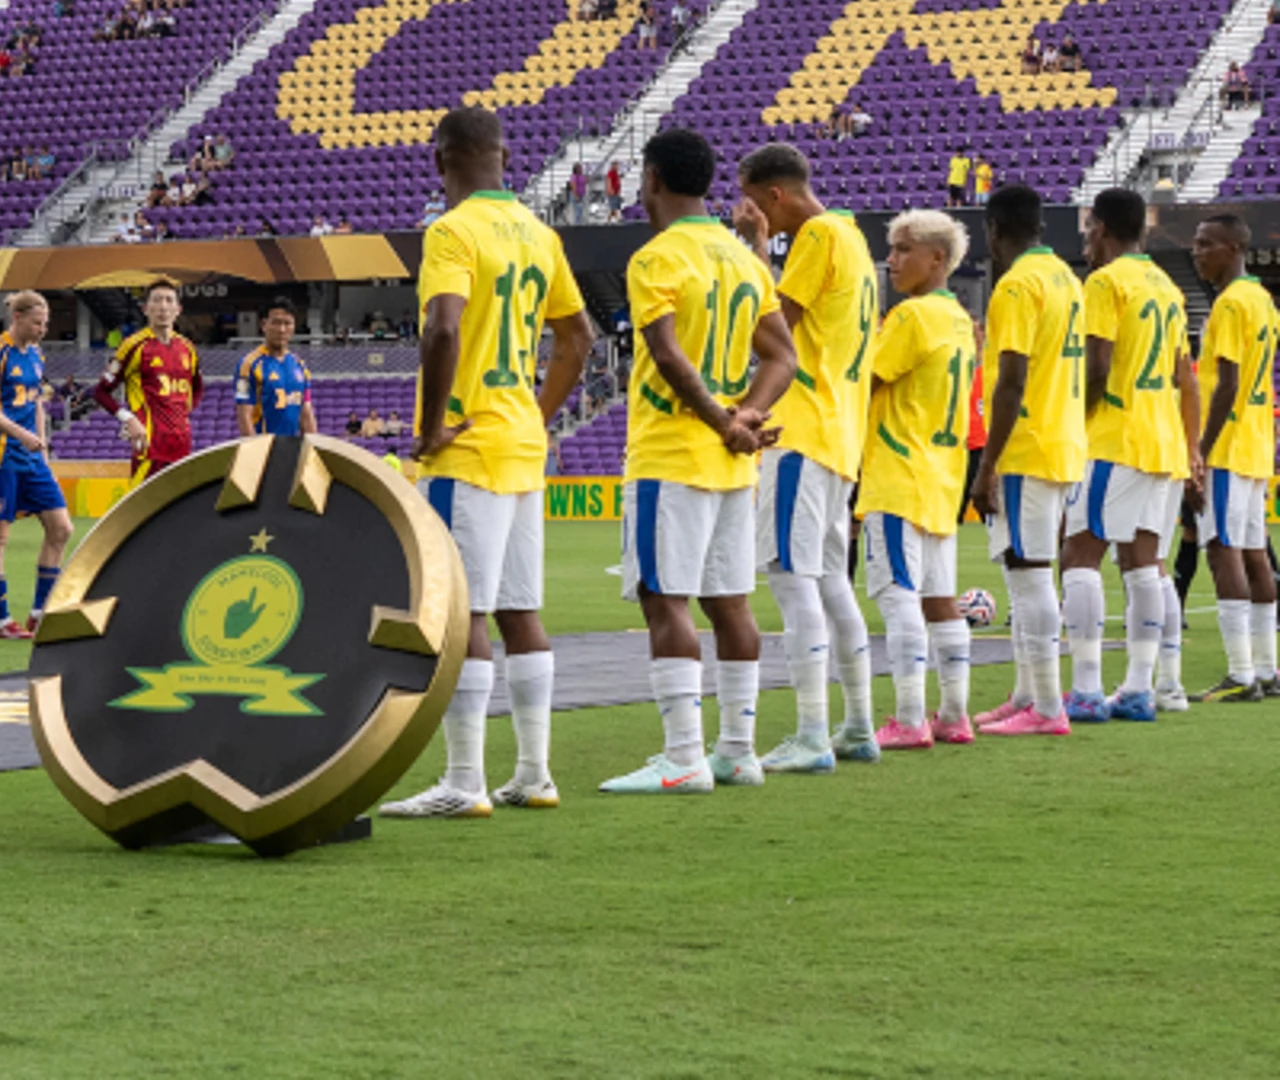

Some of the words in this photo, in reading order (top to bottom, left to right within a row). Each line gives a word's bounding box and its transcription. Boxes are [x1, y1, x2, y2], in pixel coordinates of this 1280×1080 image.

[482, 261, 547, 389] 13
[701, 280, 759, 395] 10
[845, 275, 875, 383] 9
[1062, 301, 1084, 398] 4
[545, 484, 603, 517] WNS
